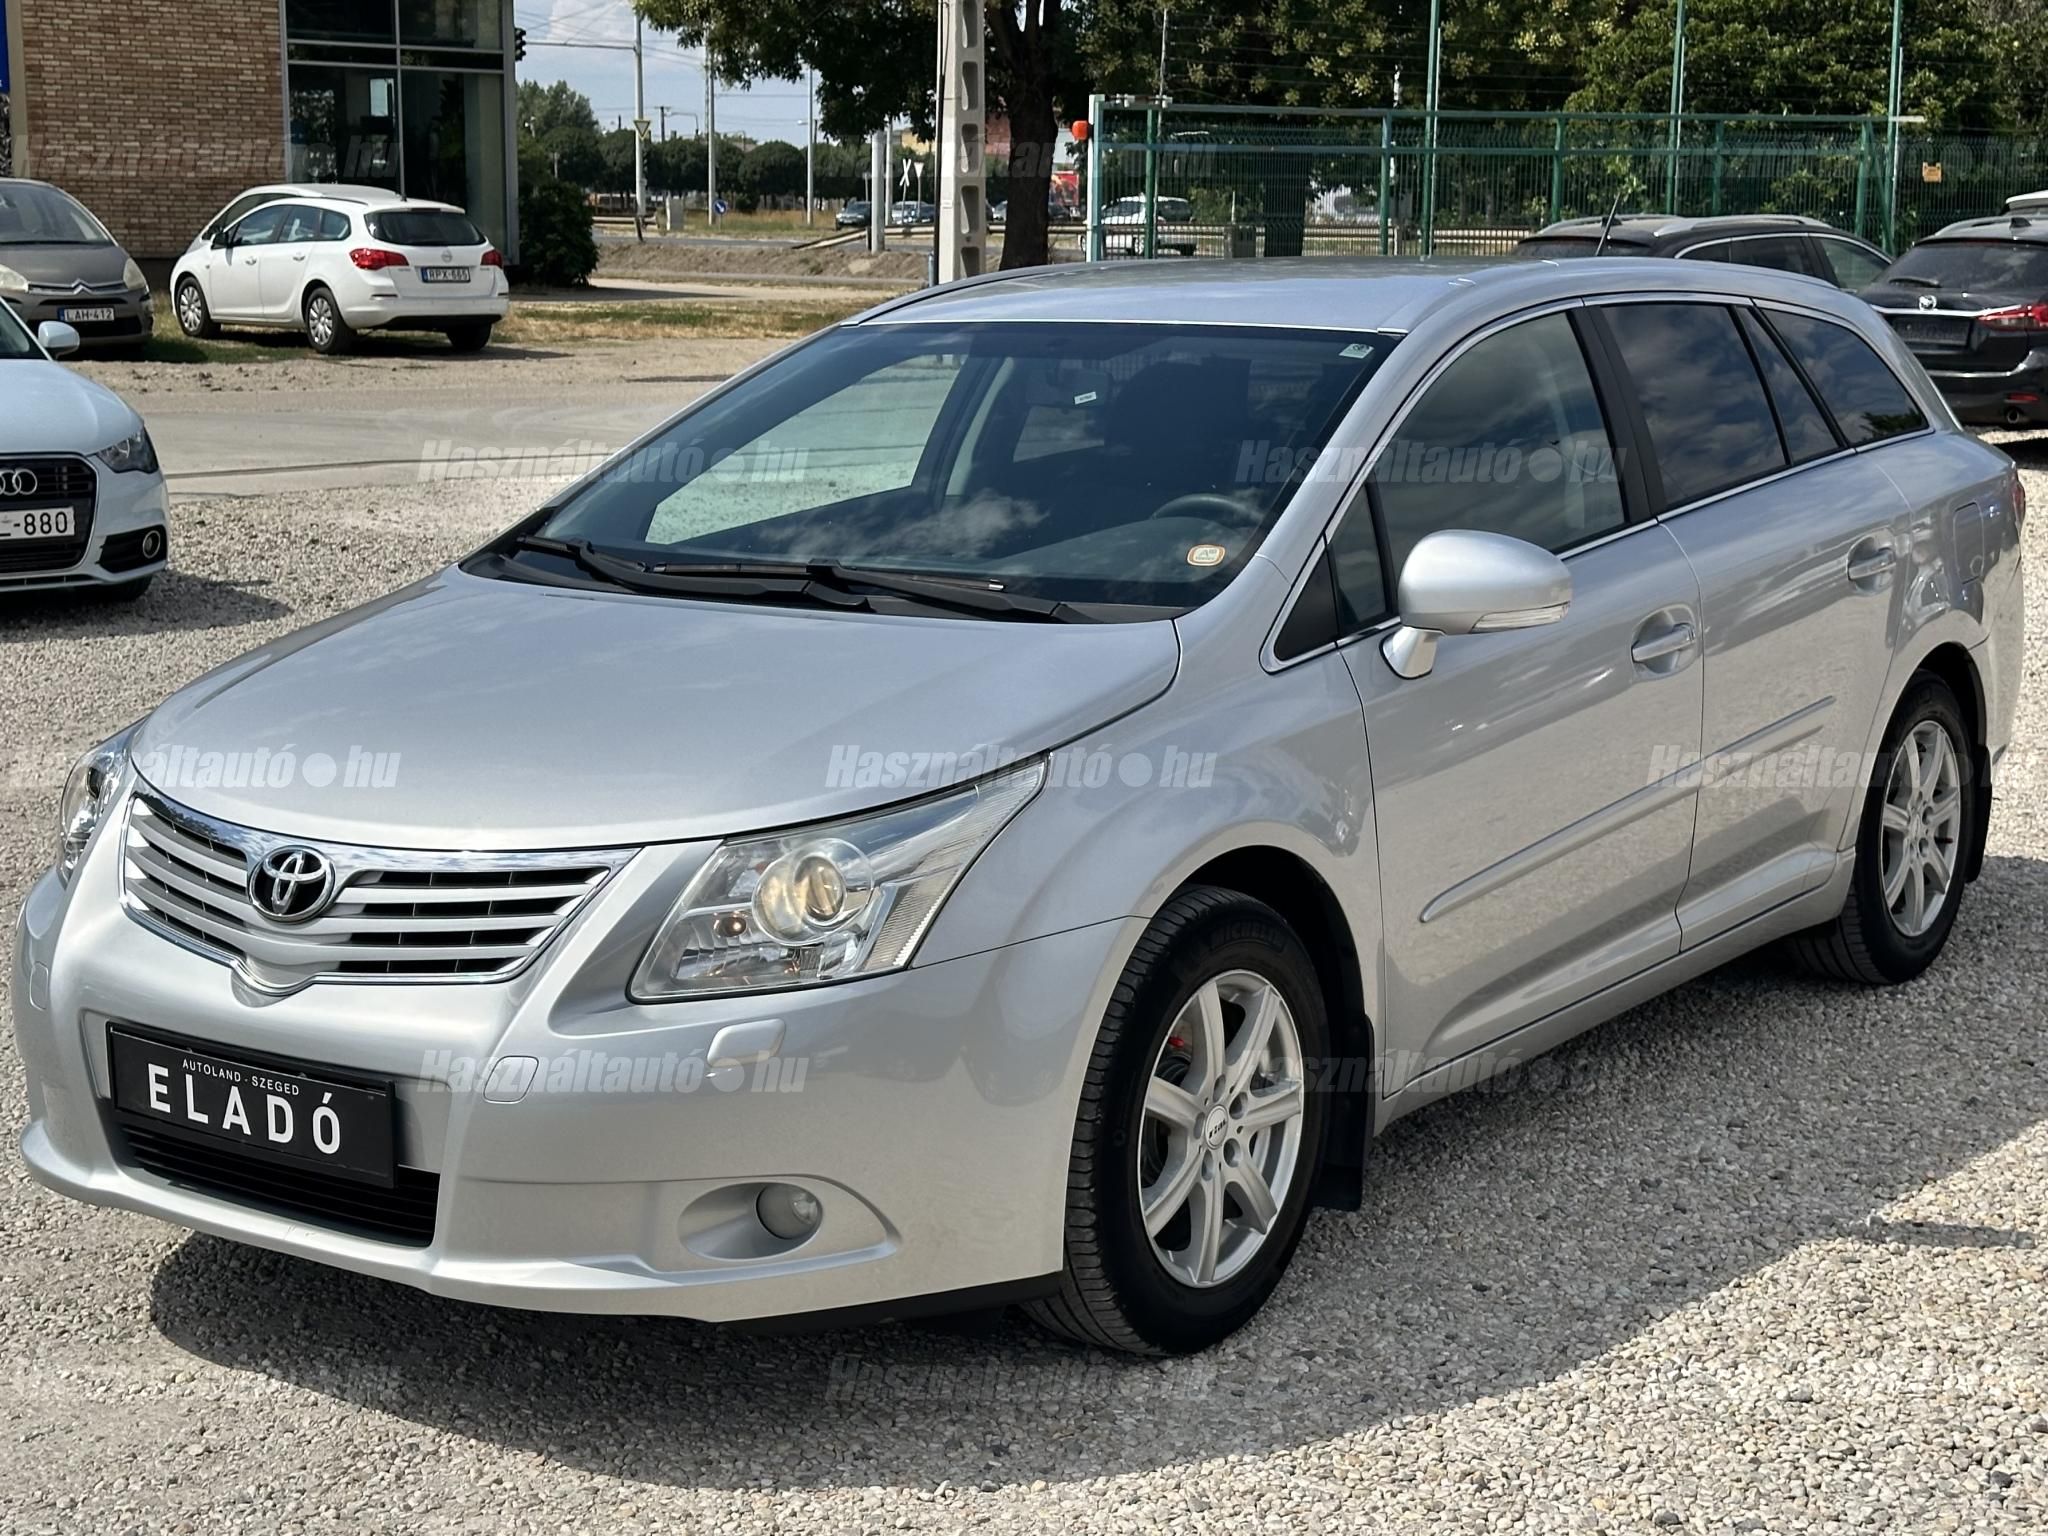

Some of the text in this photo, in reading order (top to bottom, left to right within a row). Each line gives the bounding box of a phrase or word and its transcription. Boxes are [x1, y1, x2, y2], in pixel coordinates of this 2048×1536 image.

[147, 1063, 341, 1155] ELADÓ
[182, 1058, 242, 1083] AUTOLAND
[251, 1075, 300, 1096] SZEGED
